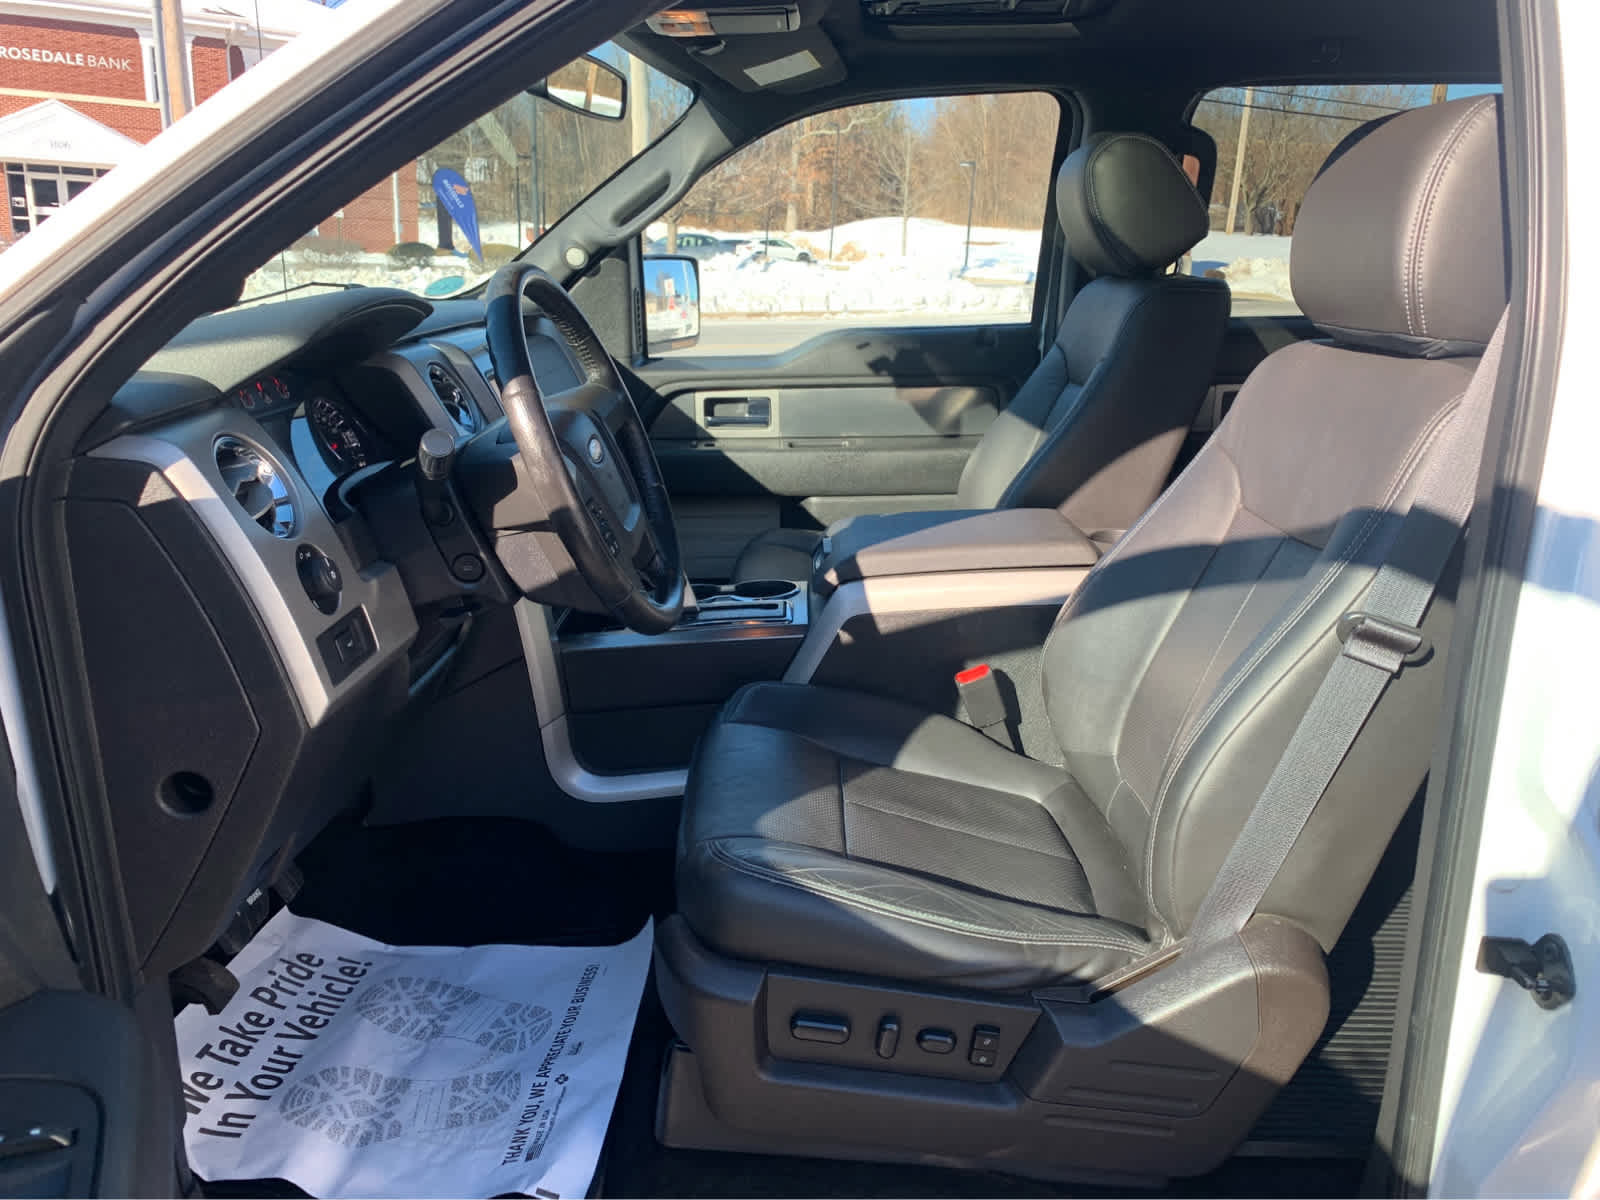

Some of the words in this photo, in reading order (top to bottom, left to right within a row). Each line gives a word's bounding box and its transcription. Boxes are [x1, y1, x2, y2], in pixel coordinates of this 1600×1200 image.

[0, 46, 84, 66] ROSEDALE
[87, 54, 132, 71] BANK
[249, 952, 324, 1010] Pride
[274, 956, 373, 1040] Vehicle!
[195, 1011, 275, 1066] Take
[560, 1005, 581, 1030] YOUR
[224, 1045, 304, 1100] Your
[536, 1028, 571, 1078] APPRECIATE
[183, 1071, 224, 1115] We
[528, 1081, 548, 1100] WE
[198, 1112, 256, 1138] In
[502, 1127, 531, 1166] THANK
